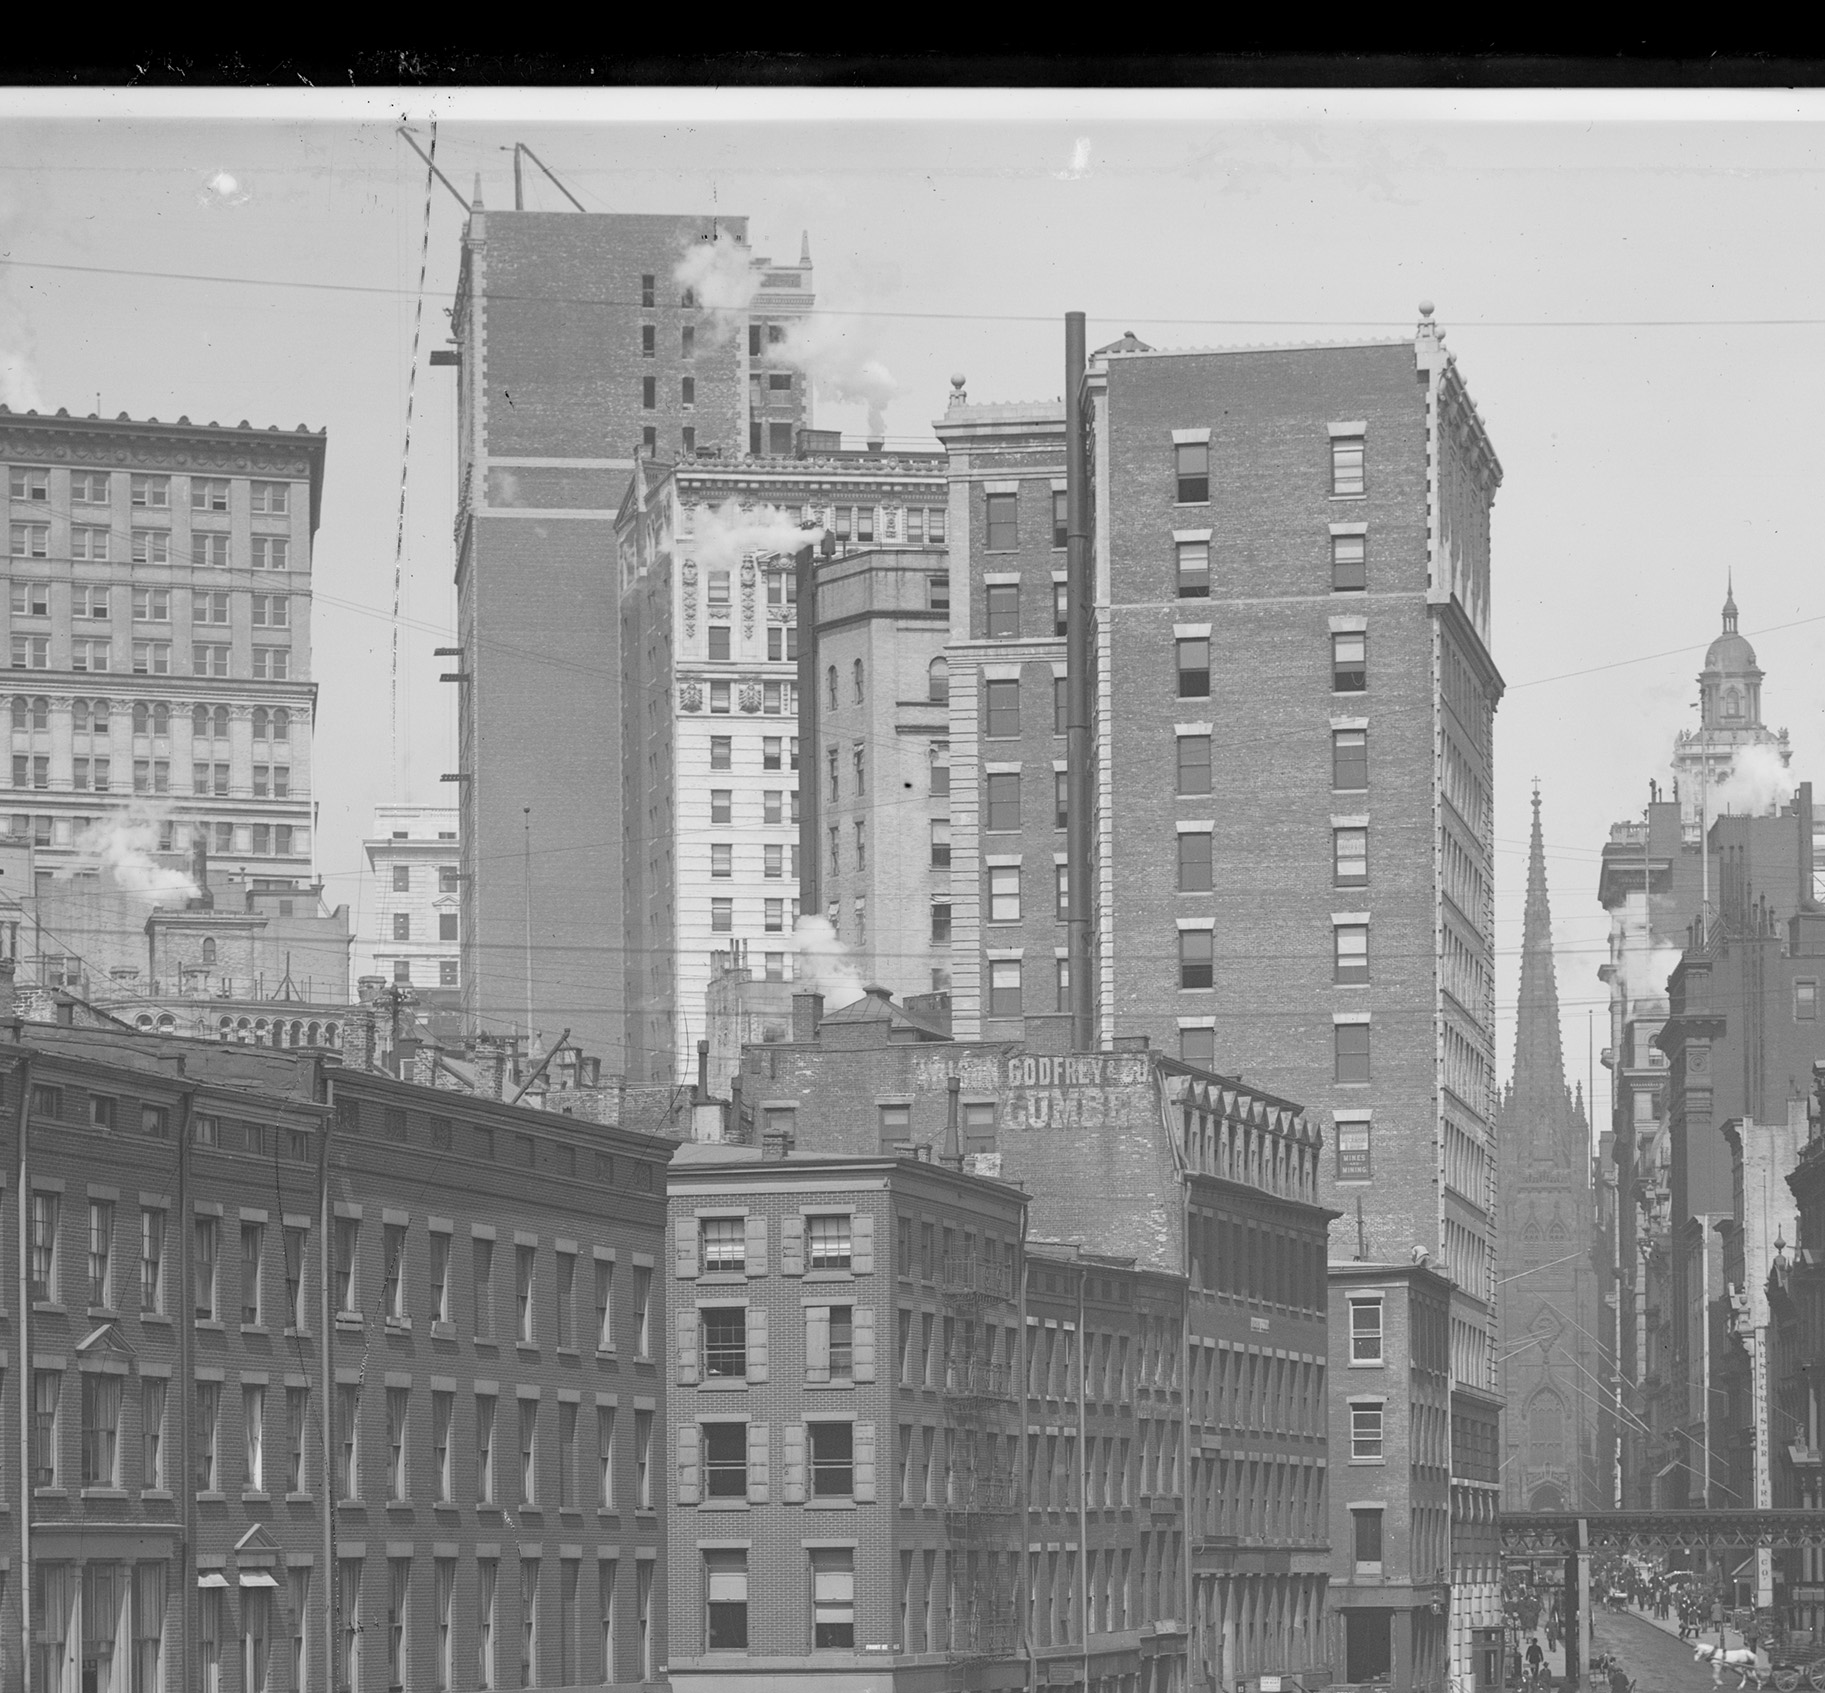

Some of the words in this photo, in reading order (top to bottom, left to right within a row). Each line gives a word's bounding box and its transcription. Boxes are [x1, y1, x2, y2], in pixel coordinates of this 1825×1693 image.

[1007, 1057, 1102, 1086] GODFREY
[1758, 1341, 1767, 1458] WESTCHESTER
[1760, 1467, 1768, 1508] FIRE
